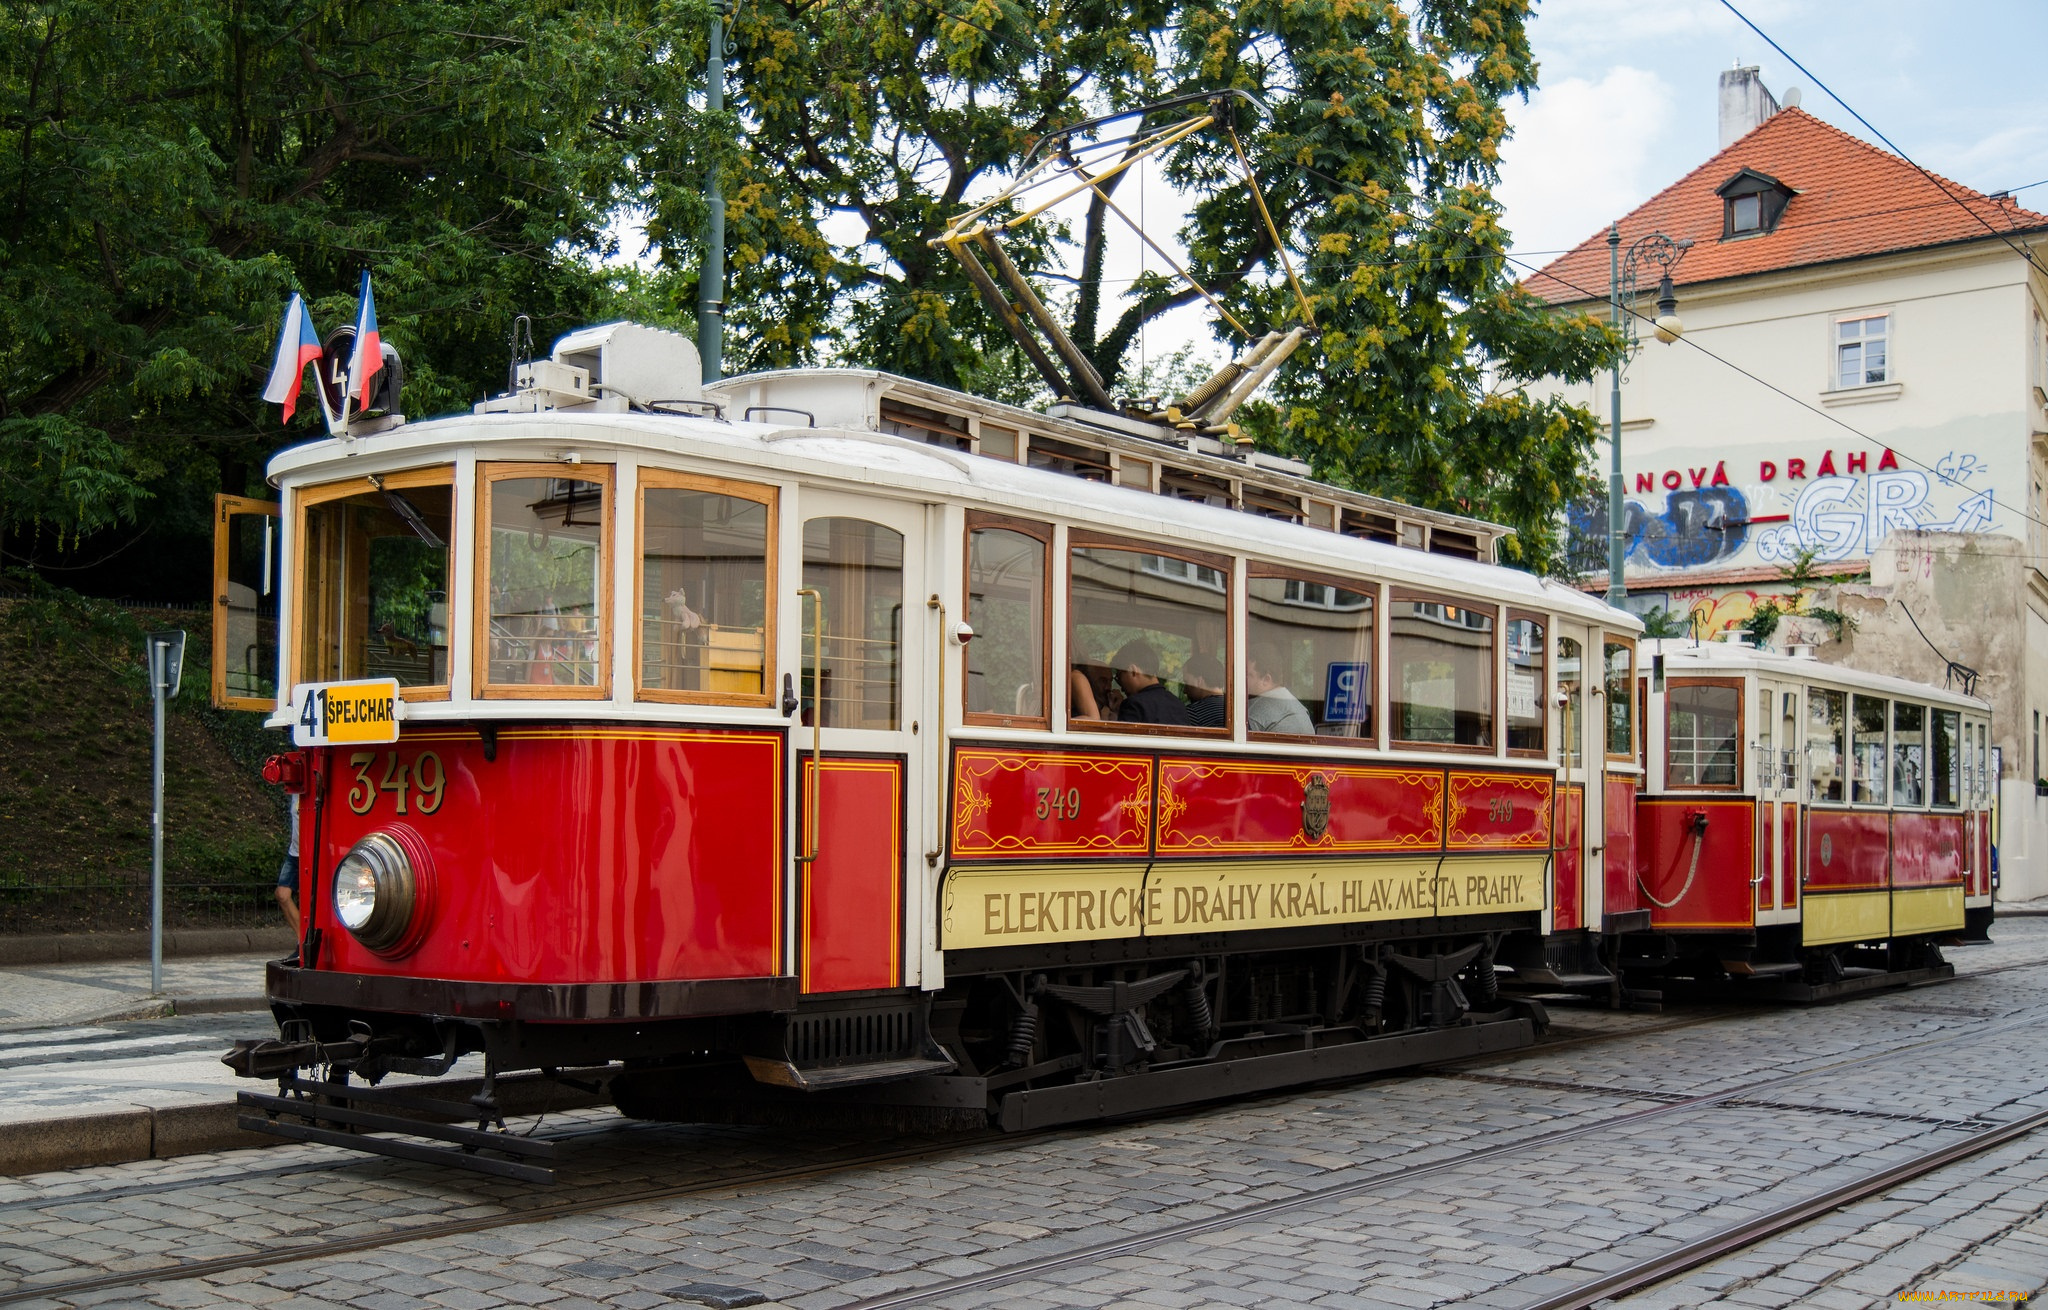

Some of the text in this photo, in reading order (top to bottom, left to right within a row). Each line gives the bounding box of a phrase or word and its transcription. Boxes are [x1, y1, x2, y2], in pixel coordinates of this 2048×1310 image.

[1589, 448, 1899, 495] NOVÁ DRÁHA
[300, 688, 395, 737] 41 ŠPEJCHAR
[348, 750, 447, 816] 349
[1036, 787, 1080, 820] 349
[1488, 797, 1513, 823] 349
[984, 878, 1163, 936] ELEKTRICKÉ
[1174, 874, 1263, 925] DRÁHY
[1466, 874, 1524, 907] PRAHY.
